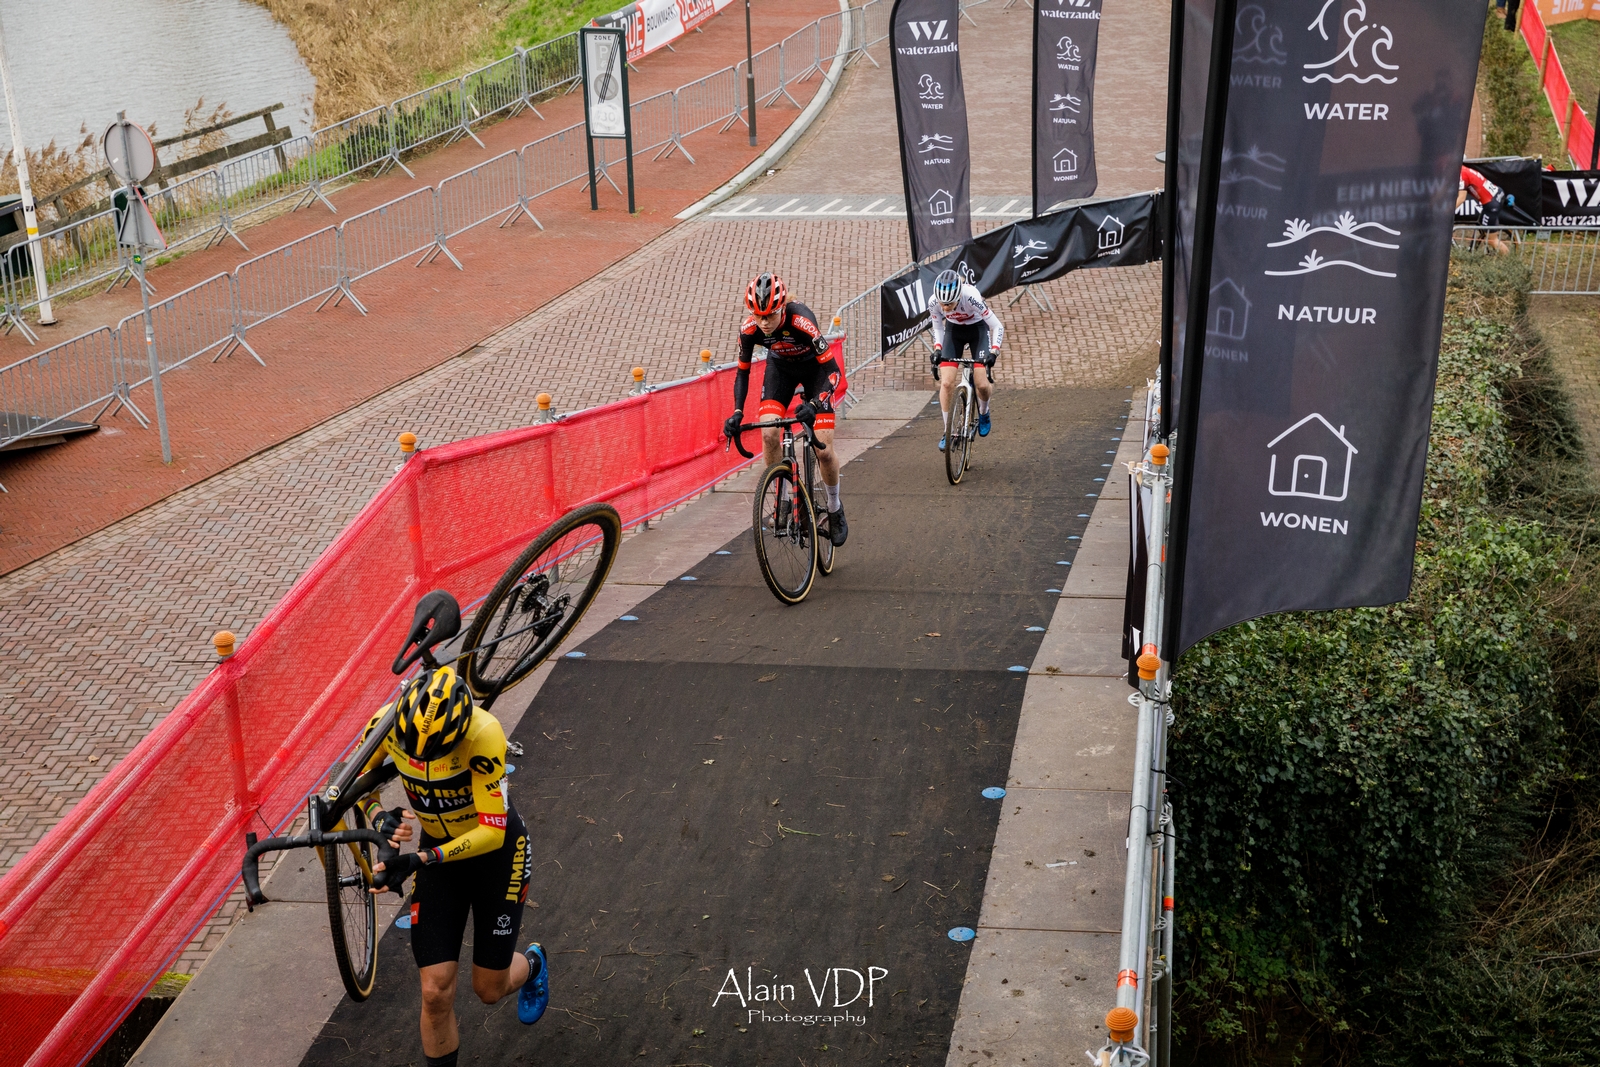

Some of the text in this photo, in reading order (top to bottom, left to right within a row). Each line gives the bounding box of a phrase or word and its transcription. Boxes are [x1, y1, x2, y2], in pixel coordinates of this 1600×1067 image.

[1041, 10, 1101, 20] waterzande
[599, 45, 609, 56] P
[1057, 63, 1079, 71] WATER
[921, 102, 944, 110] WATER
[1303, 102, 1390, 121] WATER
[1052, 117, 1077, 125] NATUUR
[923, 158, 951, 166] NATUUR
[1052, 174, 1078, 182] WONEN
[930, 217, 955, 226] WONEN
[1277, 303, 1378, 325] NATUUR
[1260, 511, 1349, 535] WONEN
[421, 701, 439, 735] MARIANNE
[433, 763, 449, 773] elfi
[448, 842, 466, 858] AGU
[505, 835, 527, 904] JUMBO
[493, 928, 513, 936] AGU
